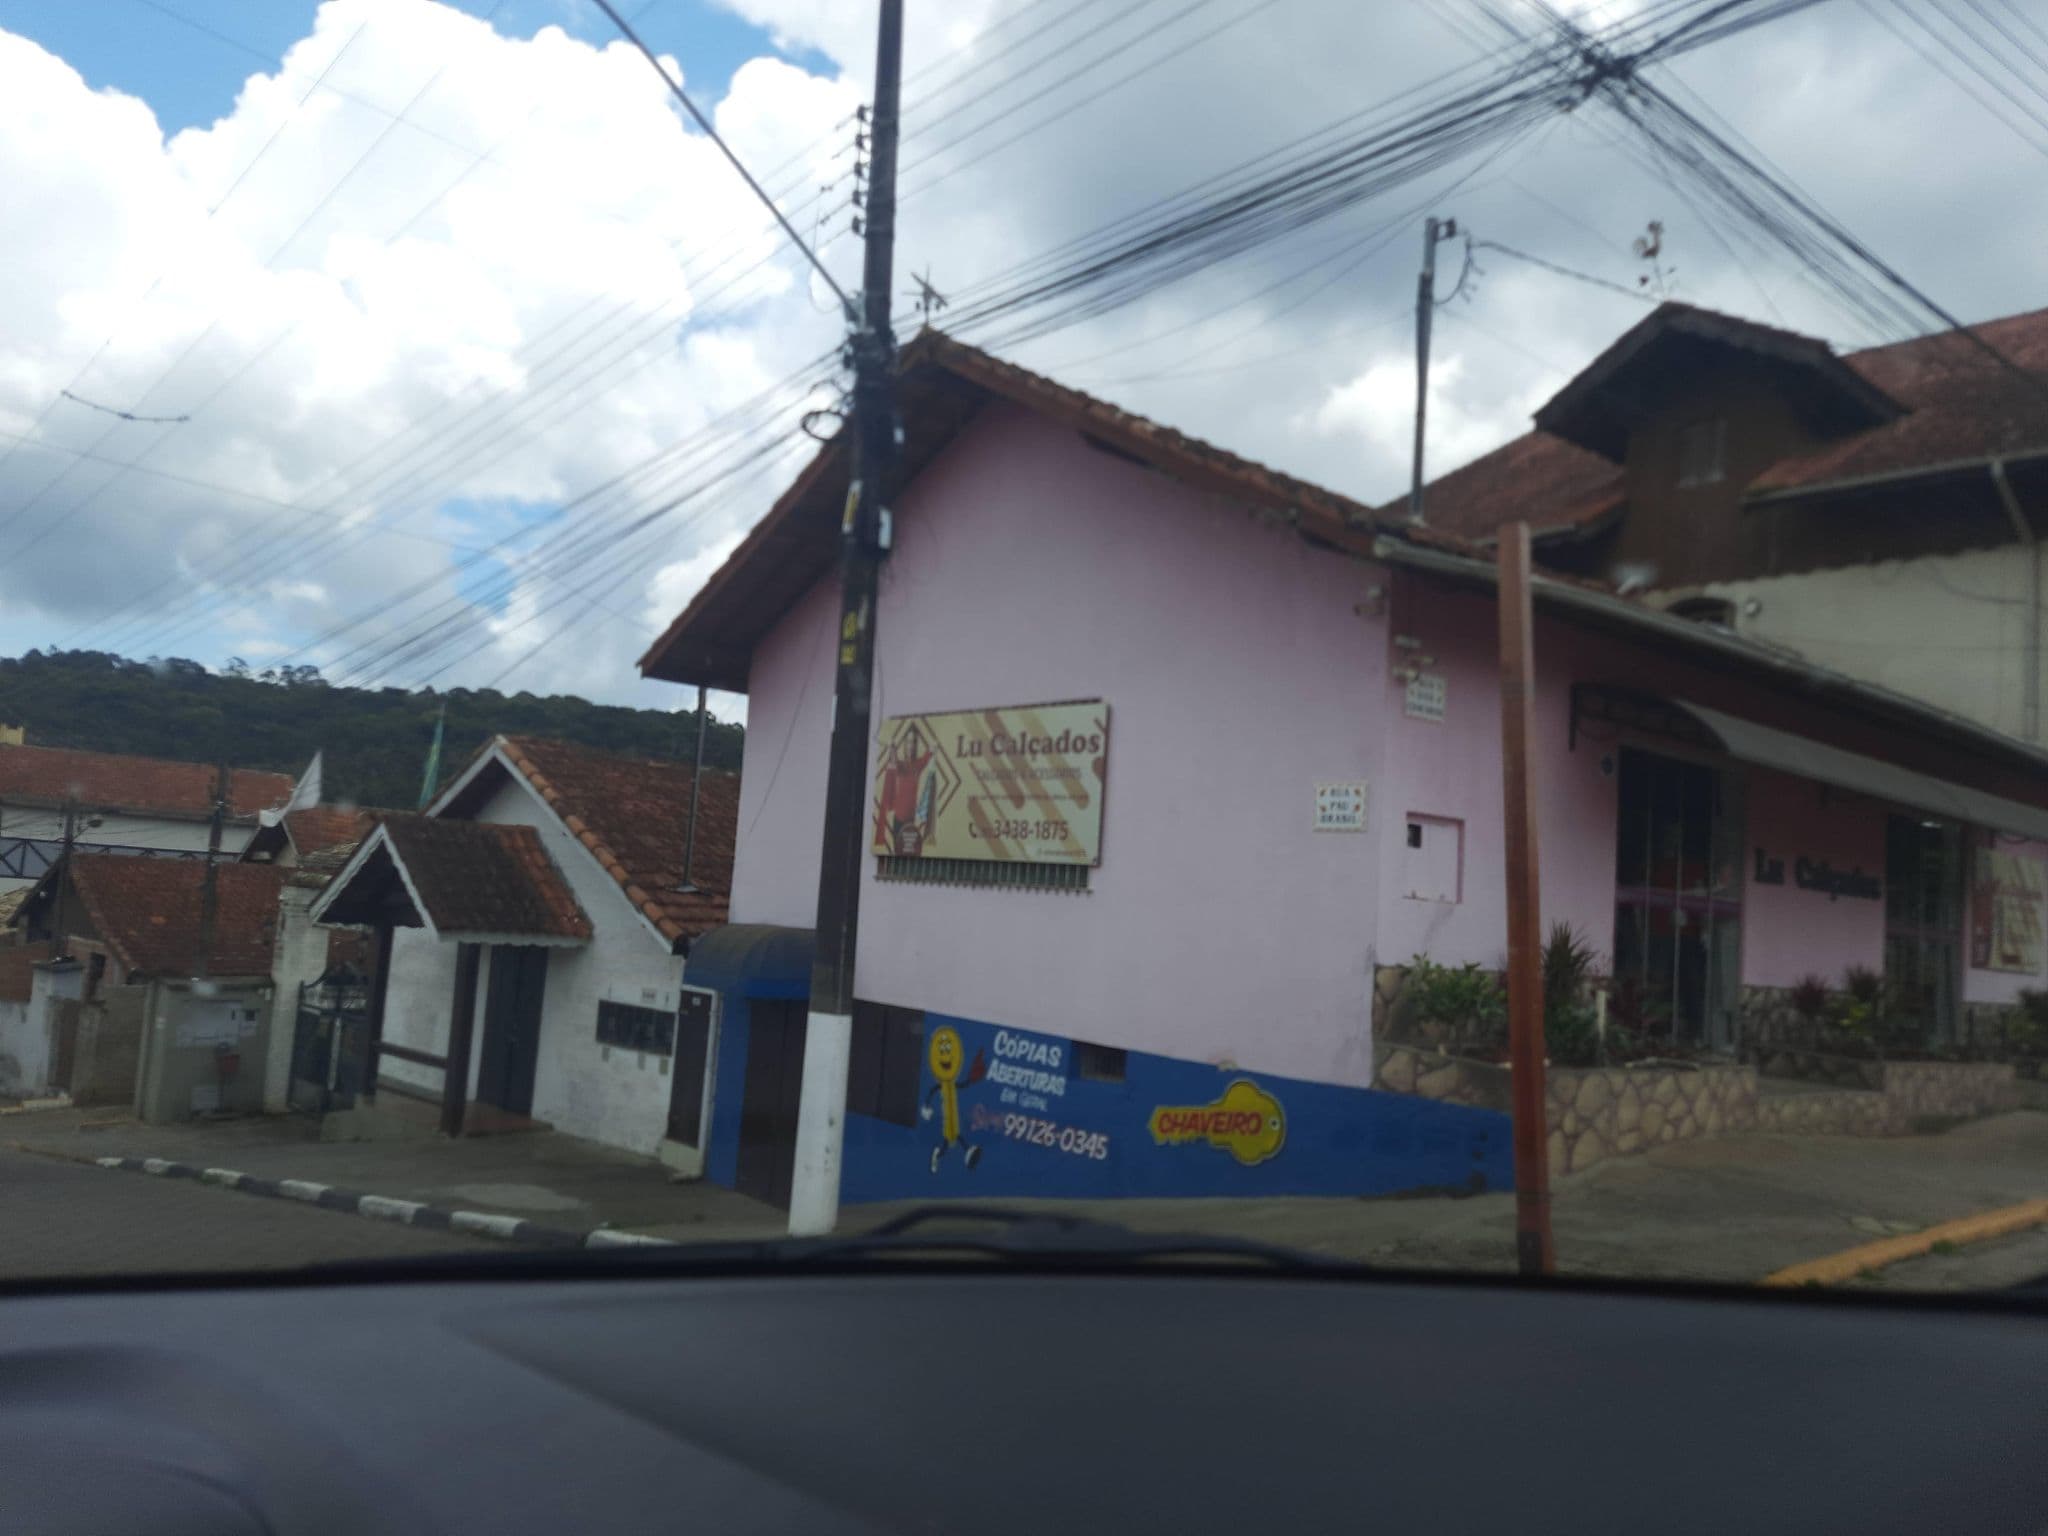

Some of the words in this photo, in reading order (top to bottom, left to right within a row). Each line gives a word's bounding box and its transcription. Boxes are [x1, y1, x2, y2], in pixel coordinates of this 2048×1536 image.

[956, 733, 982, 758] Lu
[991, 728, 1101, 761] Calçados
[993, 1030, 1062, 1068] CÓPIAS
[986, 1058, 1067, 1096] ABERTURAS
[1004, 1112, 1108, 1160] 99126-0345
[1158, 1111, 1264, 1136] CHAVEIRO
